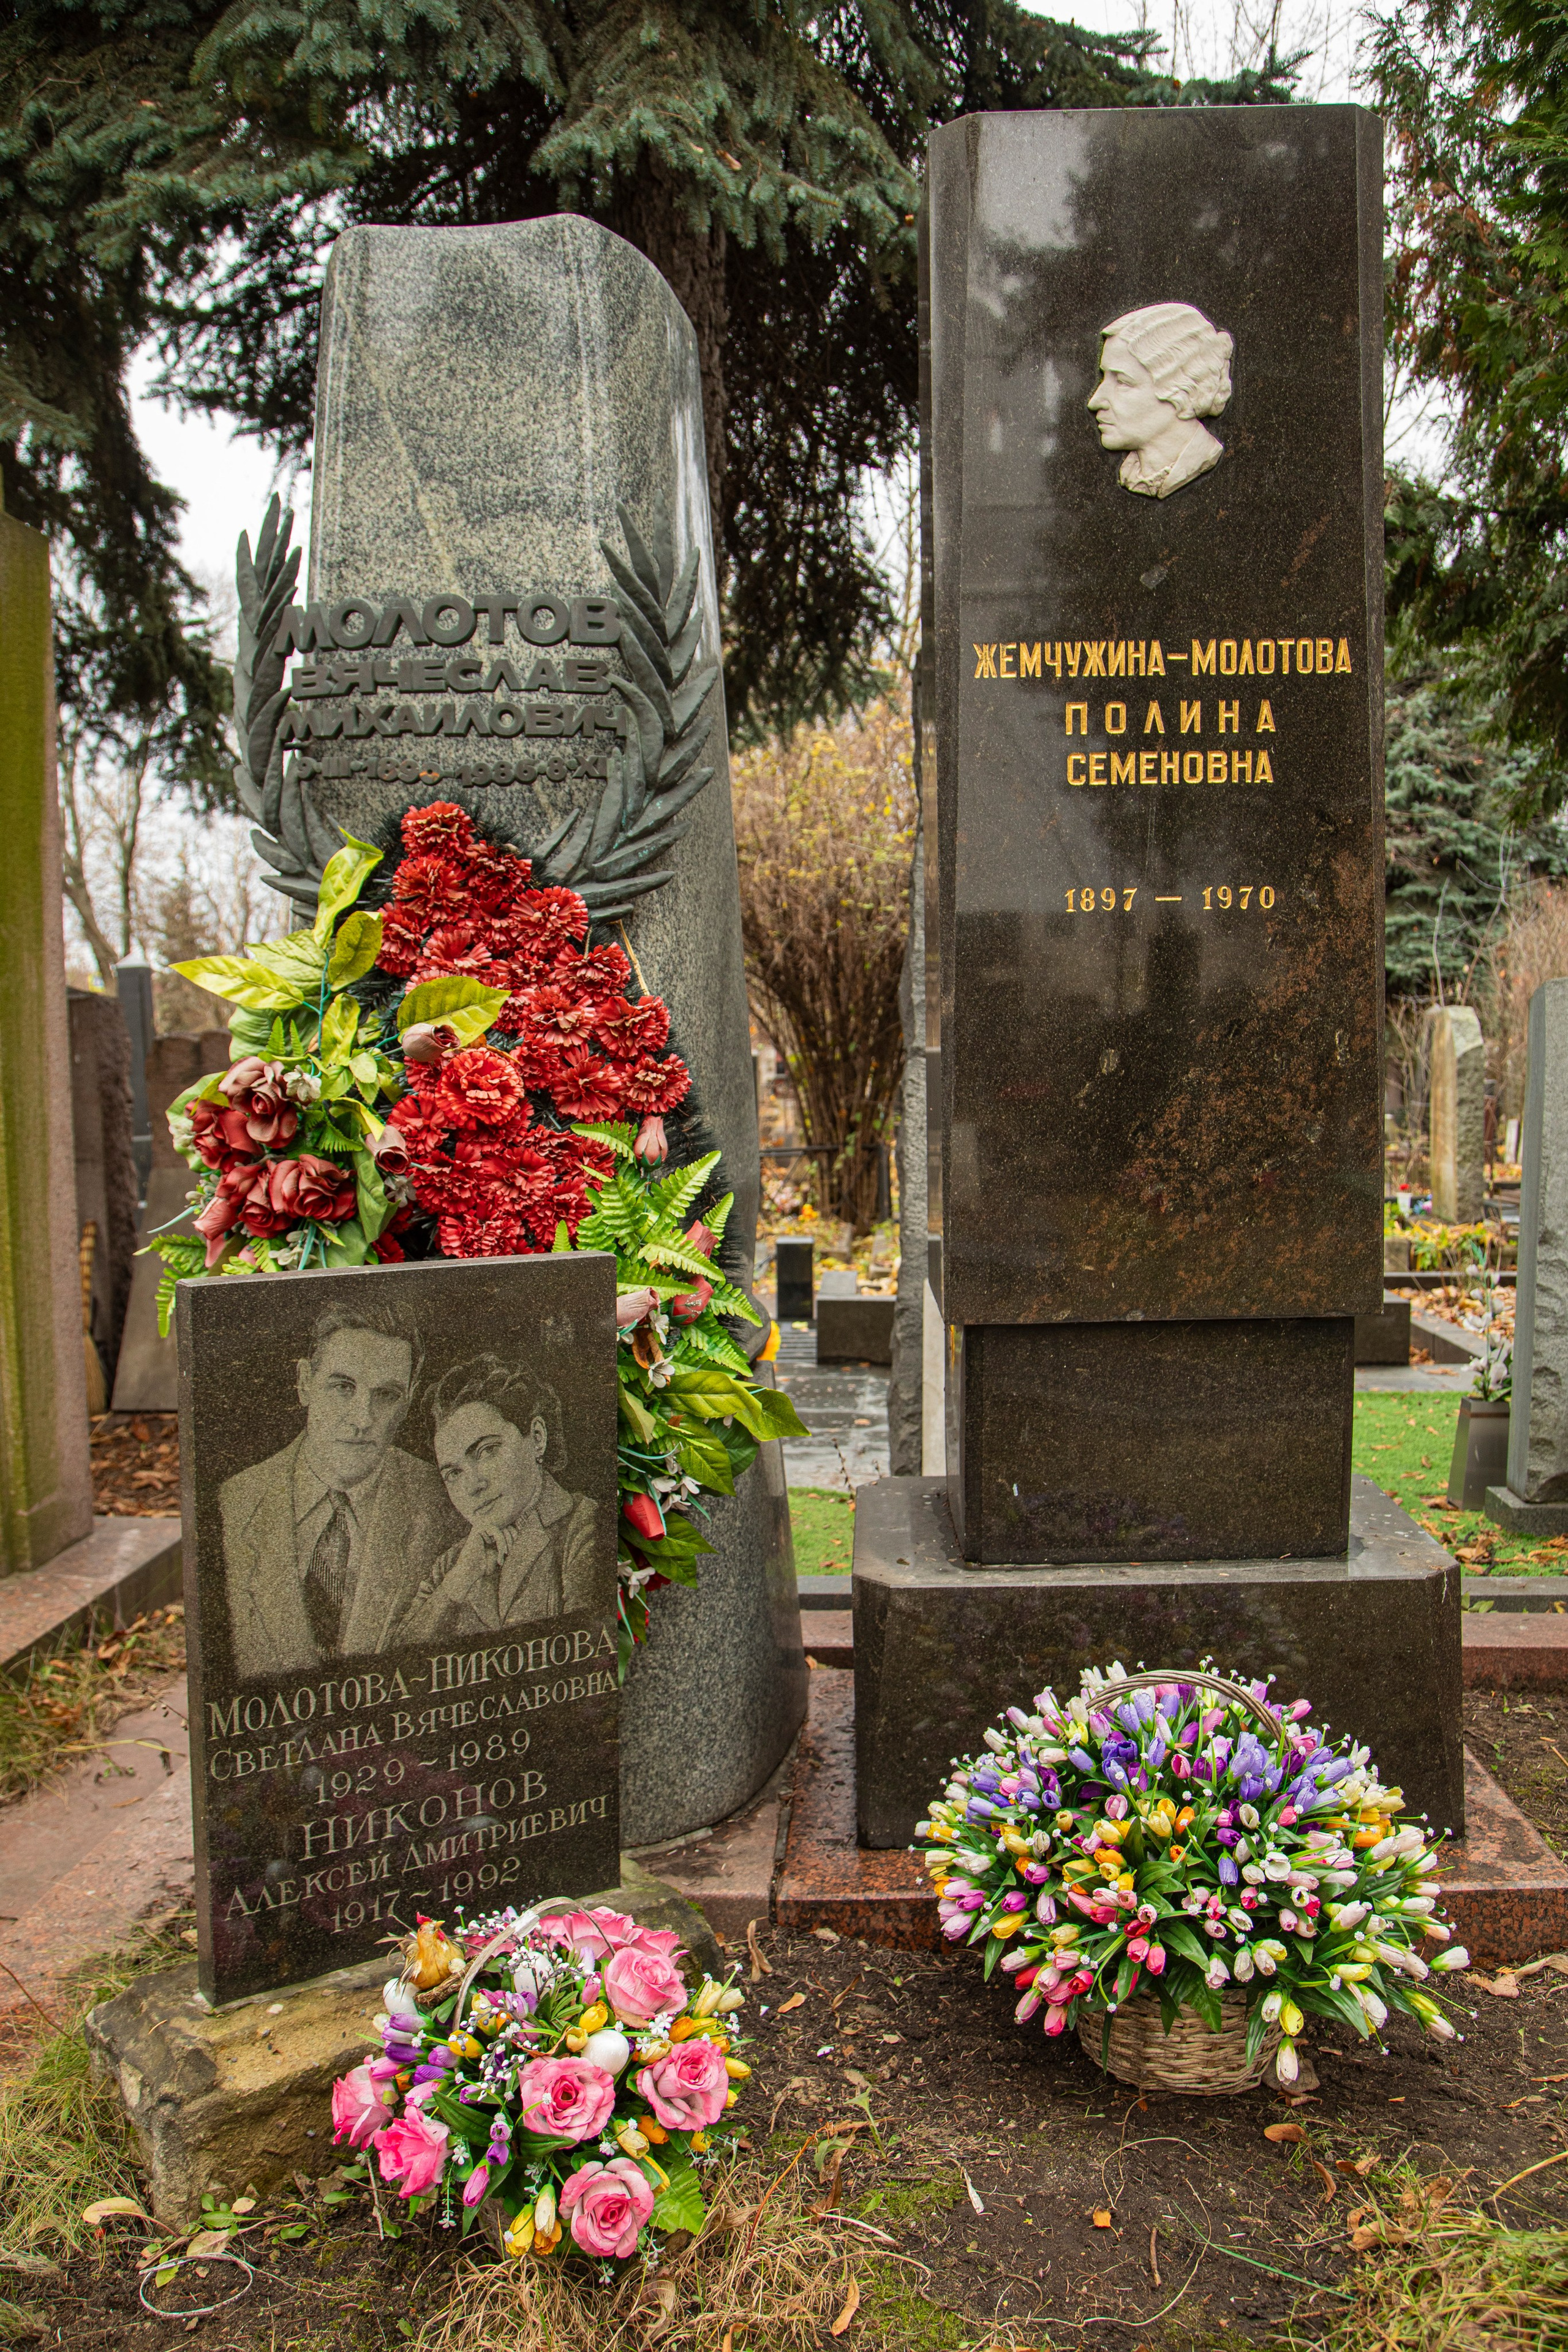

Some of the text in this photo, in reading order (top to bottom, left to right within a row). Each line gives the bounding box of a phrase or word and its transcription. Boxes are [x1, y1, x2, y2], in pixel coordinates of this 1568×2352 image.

[274, 594, 620, 655] МОЛОТОВ
[291, 658, 612, 701] ВЯЧЕСЛАВ
[279, 702, 627, 739] МИХАИЛОВИЧ
[1065, 699, 1276, 735] ПОЛИНА
[1066, 749, 1273, 785] СЕМЕНОВНА
[1065, 887, 1138, 912] 1897
[1202, 886, 1275, 910] 1970
[210, 1669, 618, 1780] СВЕТЛАНА ВЯЧЕСЛАВОВНА
[314, 1758, 405, 1804] 1929
[447, 1728, 530, 1772] 1989
[298, 1771, 547, 1861] НИКОНОВ
[222, 1795, 609, 1922] АЛЕКСЕЙ ДМИТРИЕВИЧ
[330, 1889, 400, 1934] 1917
[438, 1857, 520, 1903] 1992
